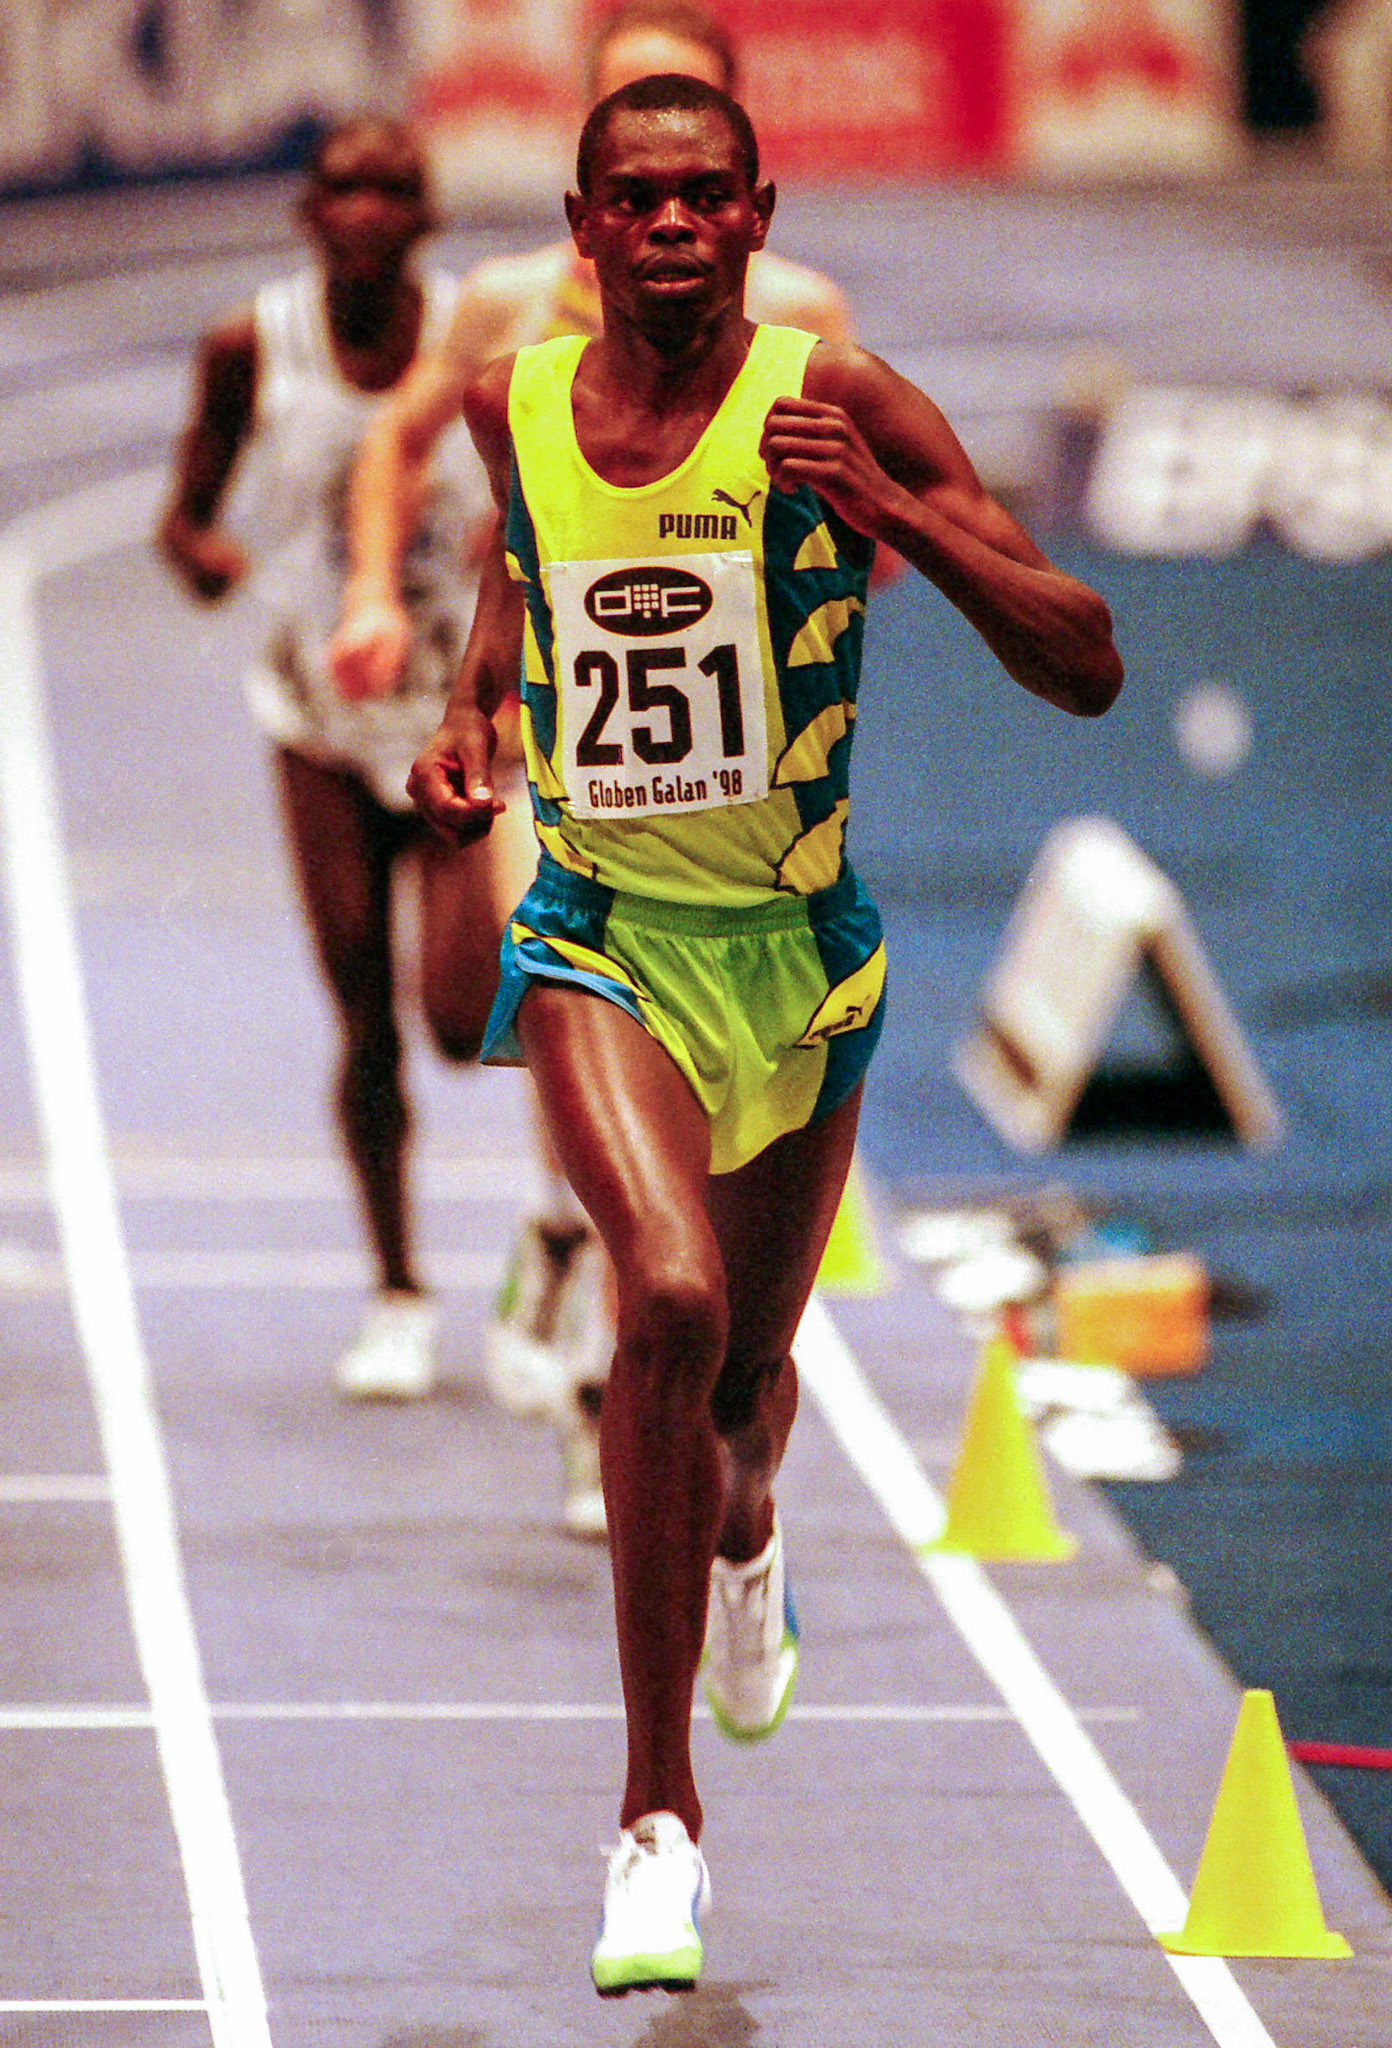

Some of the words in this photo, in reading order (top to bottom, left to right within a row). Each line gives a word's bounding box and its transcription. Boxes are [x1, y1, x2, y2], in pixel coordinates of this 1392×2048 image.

[659, 513, 737, 539] PUMA
[573, 644, 745, 767] 251
[588, 779, 647, 808] Globen
[652, 775, 707, 804] Galan
[712, 768, 743, 796] '98
